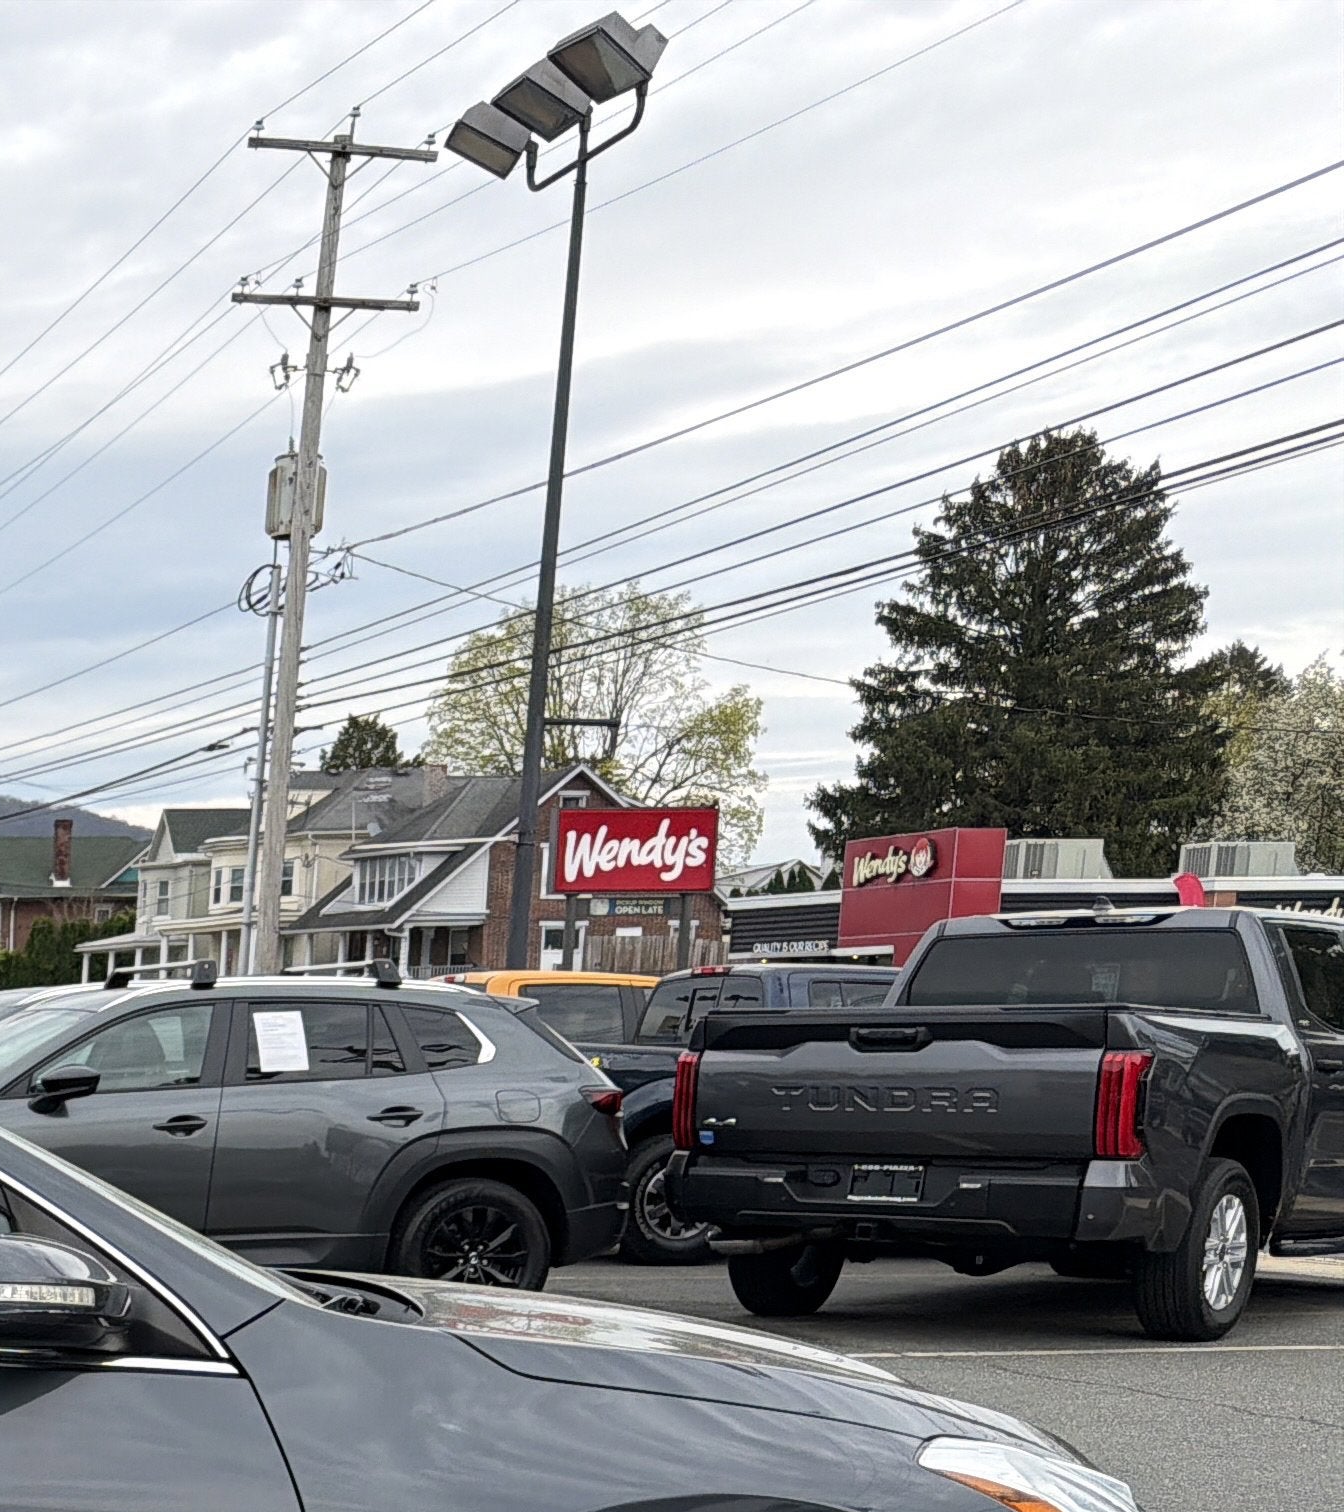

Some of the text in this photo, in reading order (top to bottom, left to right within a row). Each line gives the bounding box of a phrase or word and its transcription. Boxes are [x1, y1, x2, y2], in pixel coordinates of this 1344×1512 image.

[564, 818, 709, 883] Wendy's
[852, 845, 908, 887] Wendy's
[615, 906, 664, 914] OPEN LATE
[753, 942, 781, 954] QUALITY
[771, 1086, 1000, 1113] TUNDRA
